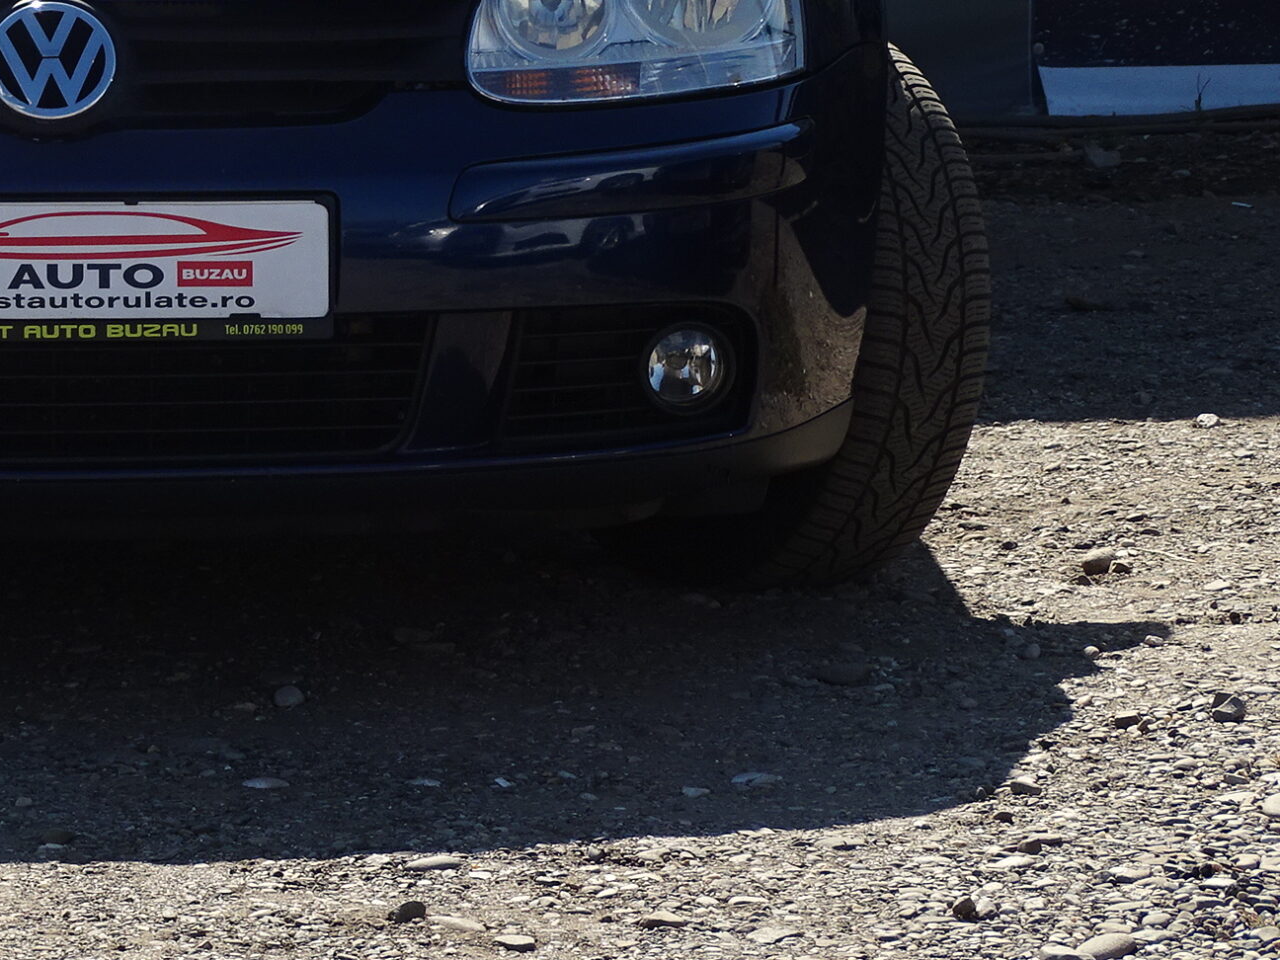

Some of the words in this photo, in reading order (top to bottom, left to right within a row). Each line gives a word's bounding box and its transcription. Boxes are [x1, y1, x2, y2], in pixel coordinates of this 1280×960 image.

[7, 263, 165, 290] AUTO
[182, 268, 247, 280] BUZAU
[23, 324, 97, 338] AUTO
[106, 323, 198, 338] BUZAU
[225, 324, 241, 335] Tel.
[243, 325, 266, 335] 0762
[268, 324, 284, 335] 190
[285, 324, 303, 335] 099
